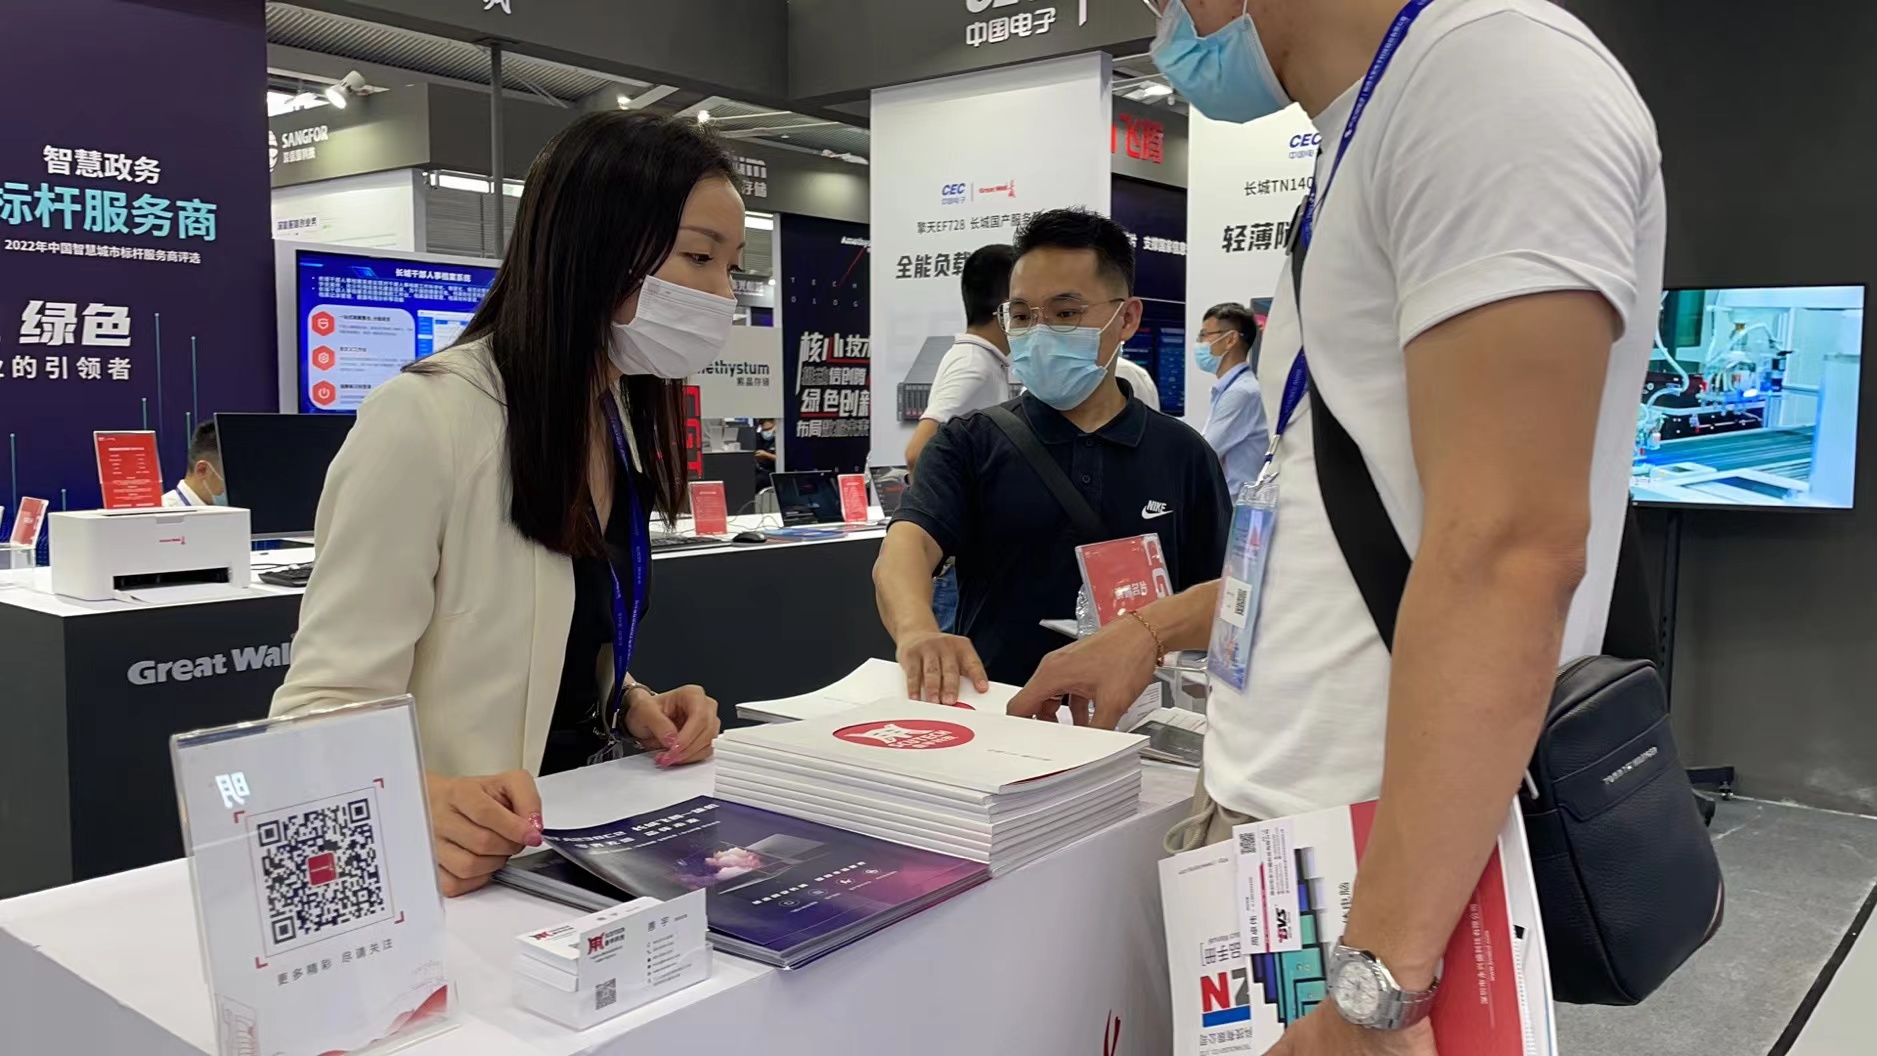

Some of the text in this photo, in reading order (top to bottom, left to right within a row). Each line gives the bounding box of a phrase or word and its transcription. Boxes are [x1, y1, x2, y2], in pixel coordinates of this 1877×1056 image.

[965, 7, 1057, 47] 中国电子
[281, 125, 329, 149] SANGFOR
[1118, 113, 1164, 163] 飞腾
[1289, 132, 1322, 148] CEC
[43, 145, 161, 184] 智慧政务
[941, 183, 966, 196] CEC
[916, 214, 966, 234] 擎天EF728
[4, 239, 202, 264] 2022年中国智慧城市标杆服务商评选
[395, 268, 472, 283] 长城干部人事档案系统
[19, 300, 131, 347] 绿色
[0, 355, 131, 380] 的引领者
[1146, 500, 1168, 513] NIKE
[127, 652, 228, 685] Great
[277, 957, 332, 987] 更多精彩
